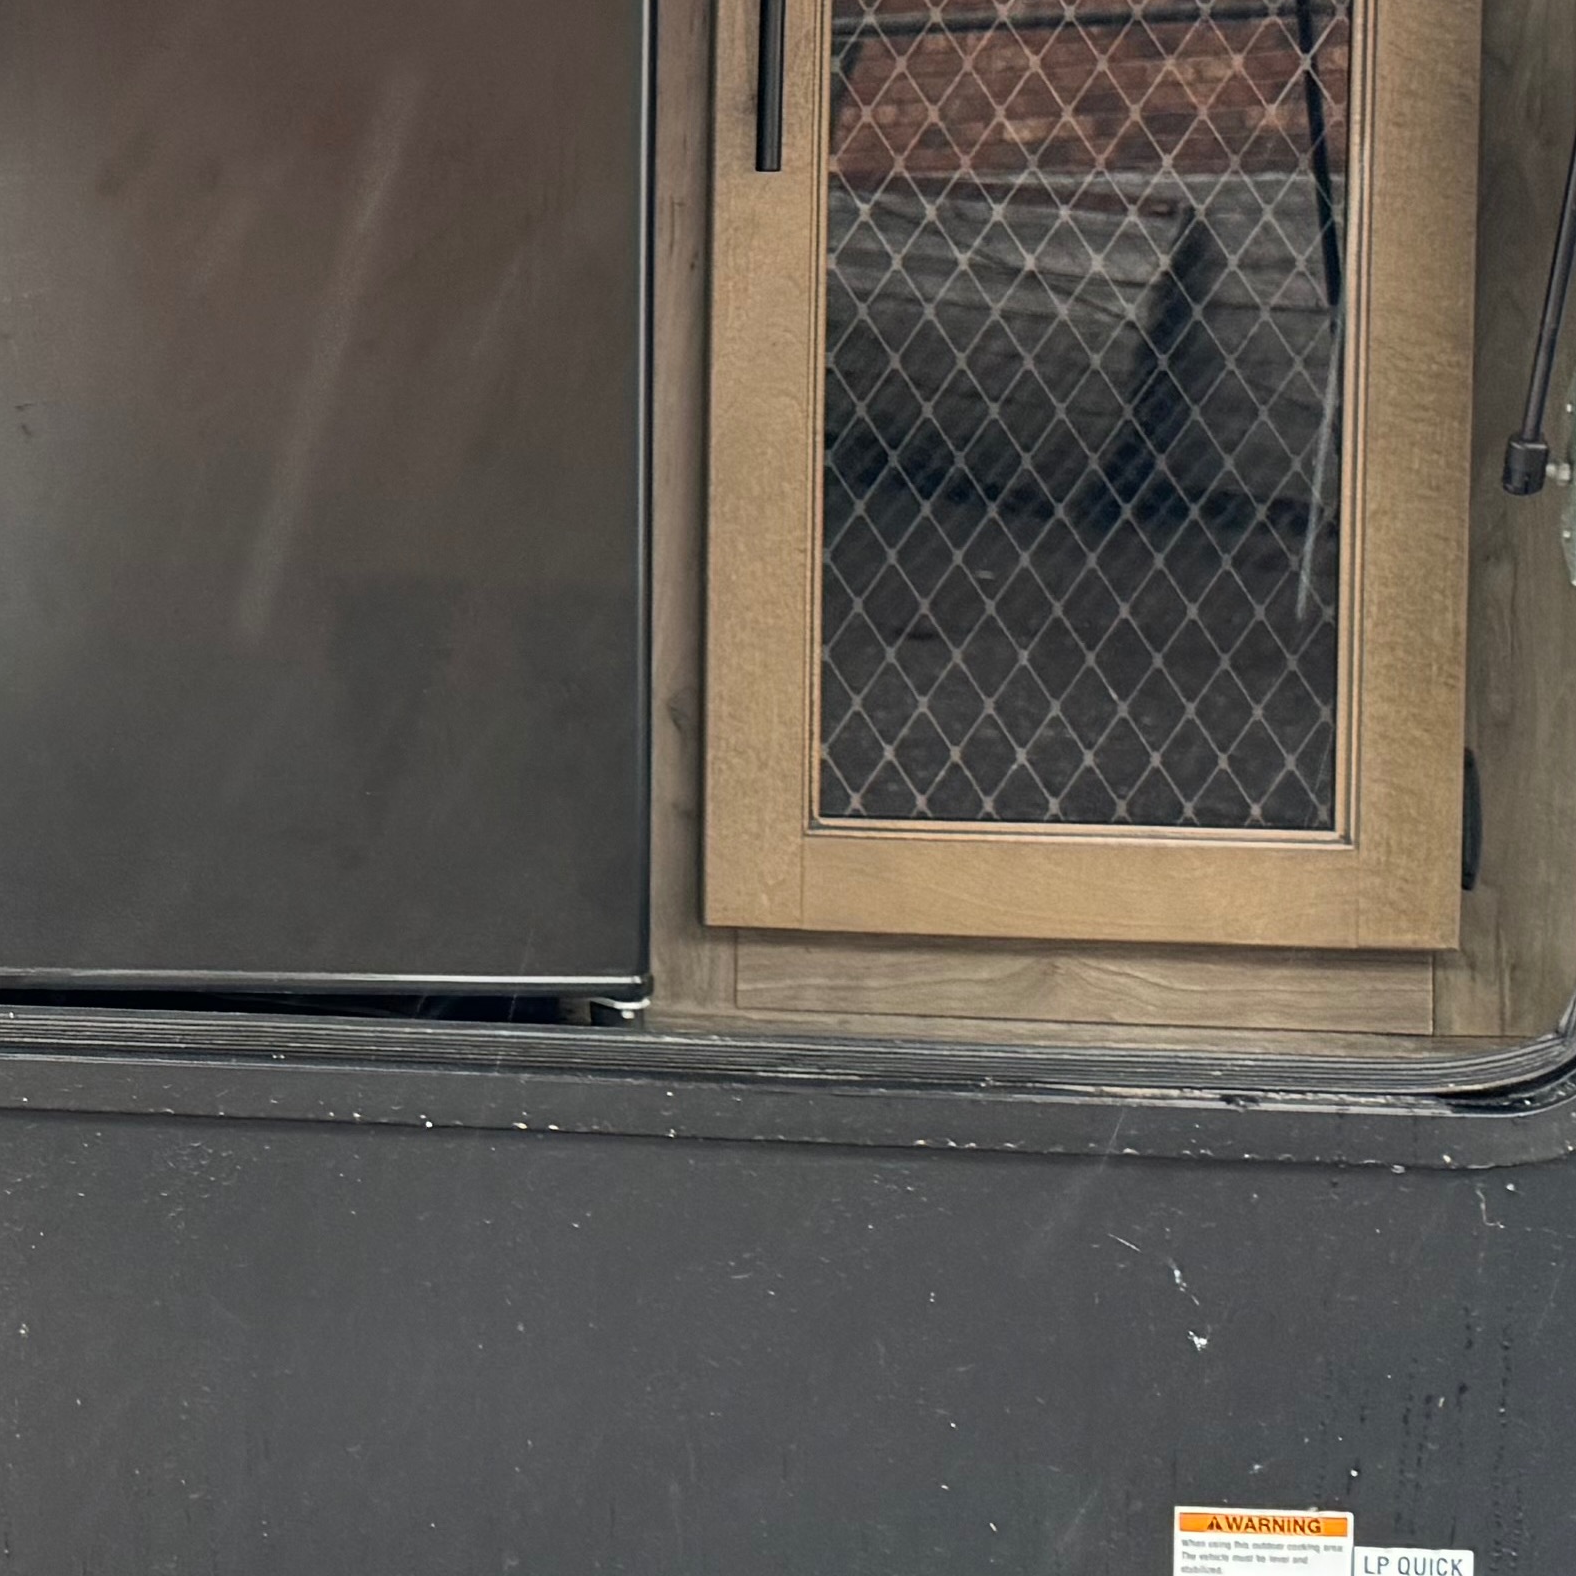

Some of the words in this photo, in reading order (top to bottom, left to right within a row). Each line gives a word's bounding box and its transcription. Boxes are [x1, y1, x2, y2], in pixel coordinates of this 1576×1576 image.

[1225, 1515, 1322, 1534] WARNING
[1364, 1555, 1389, 1576] LP
[1397, 1557, 1464, 1576] QUICK
